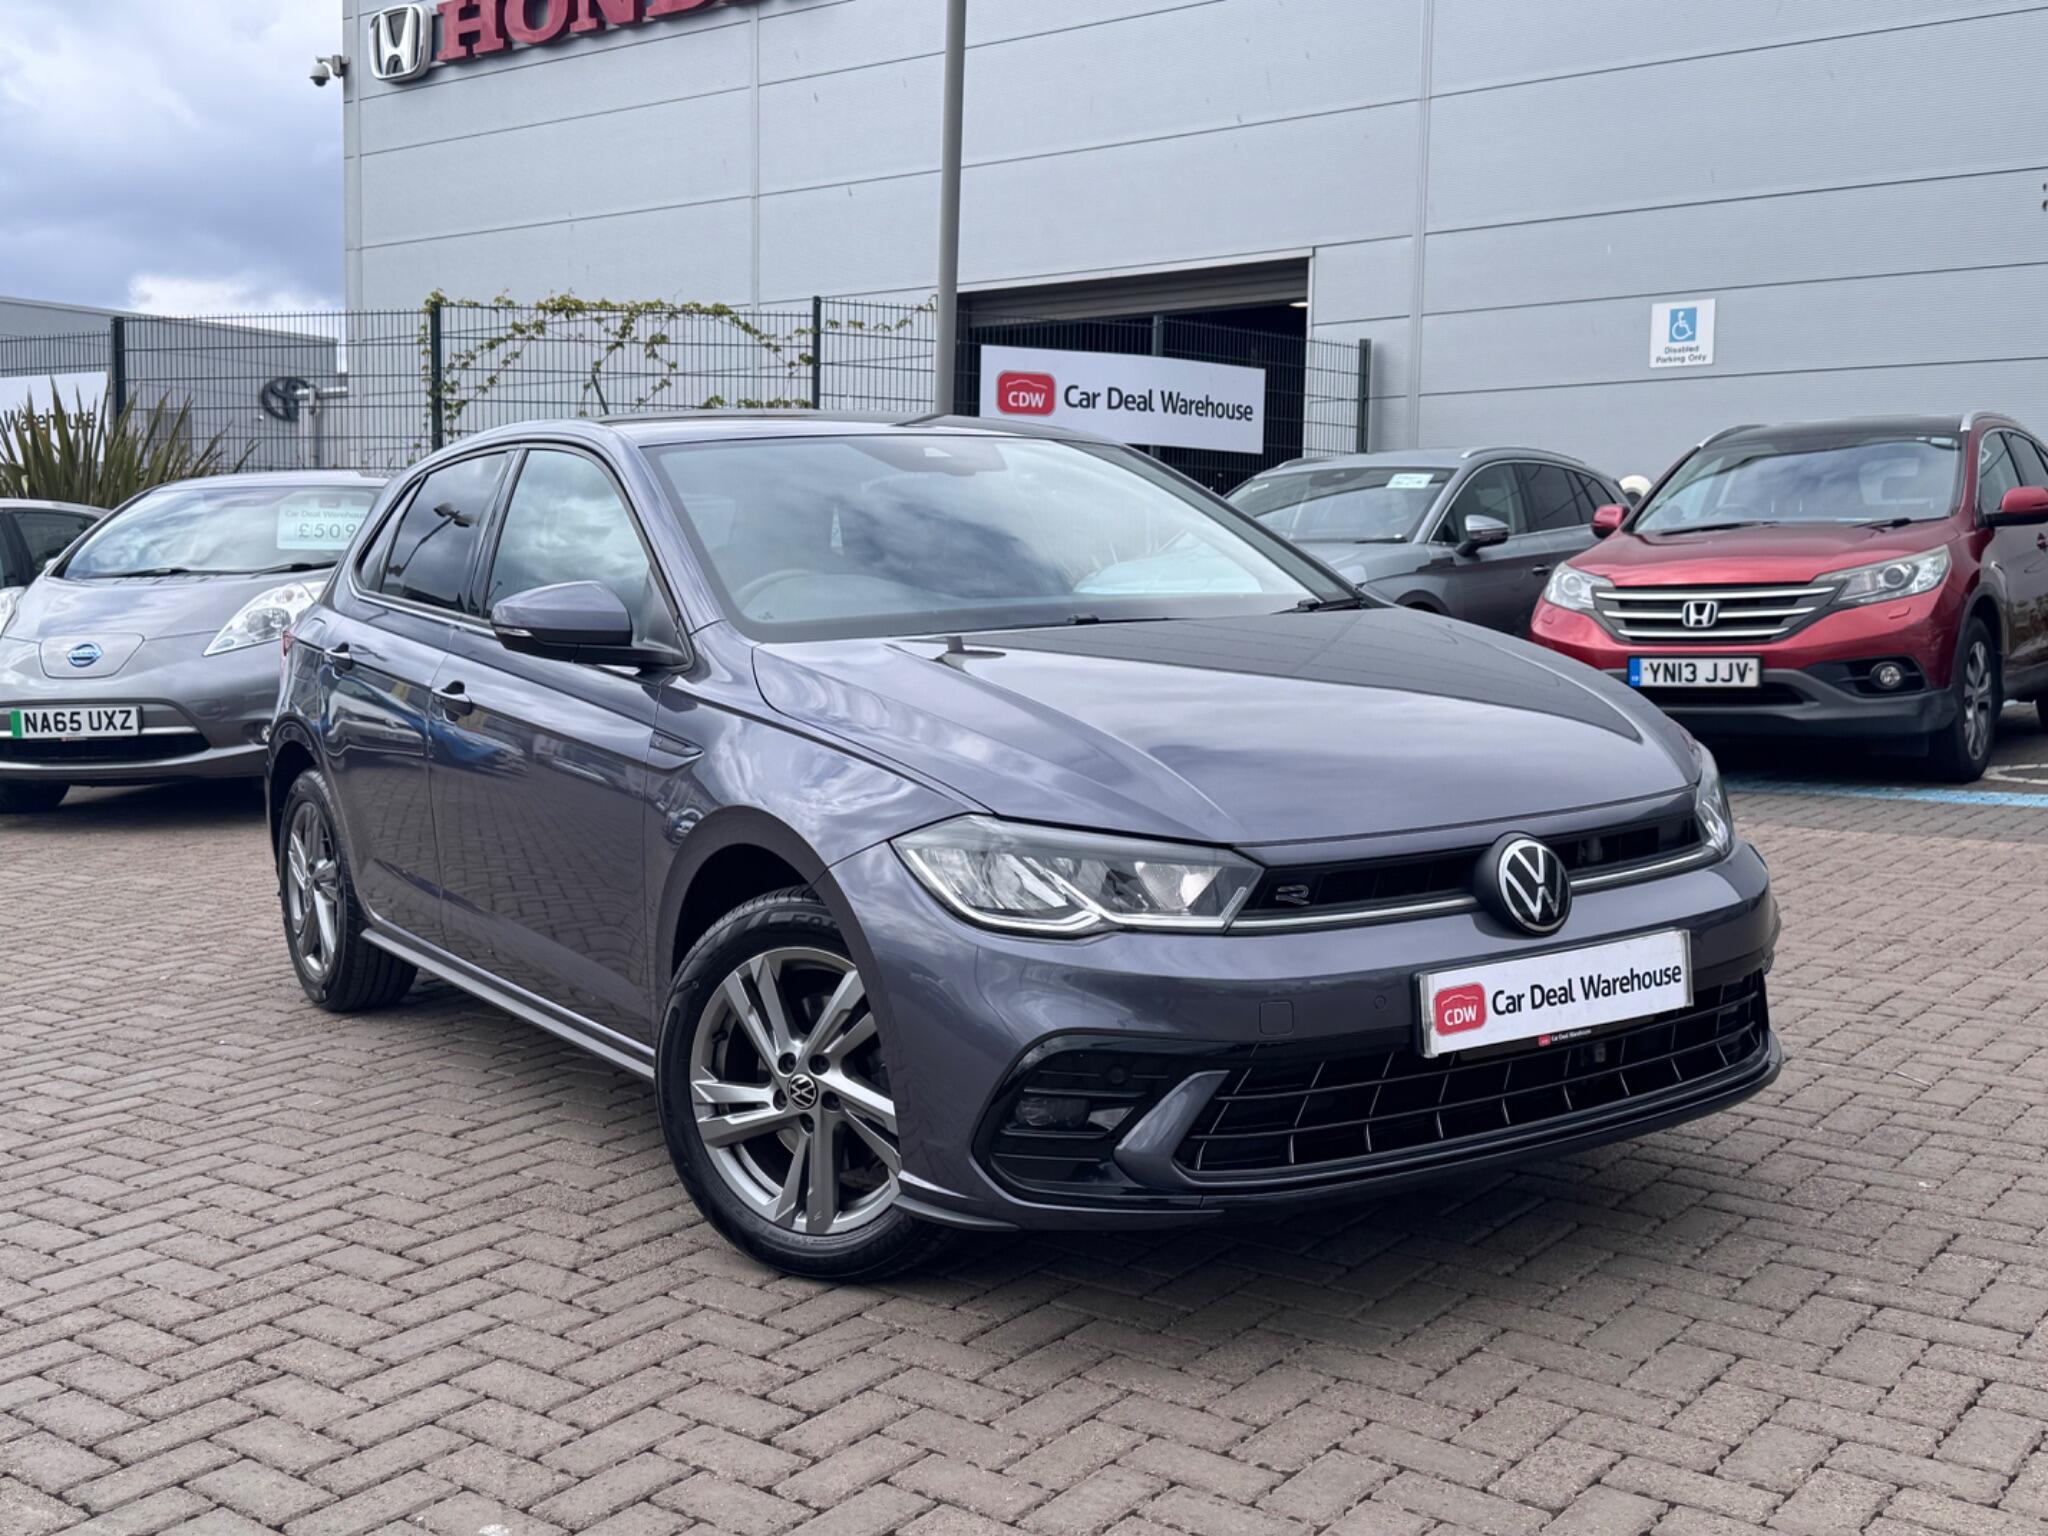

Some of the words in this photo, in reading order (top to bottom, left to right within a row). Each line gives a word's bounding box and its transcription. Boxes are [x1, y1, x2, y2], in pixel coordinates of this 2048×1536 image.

[1007, 391, 1046, 408] CDW
[1063, 384, 1101, 410] Car
[1107, 386, 1155, 413] Deal
[1160, 390, 1254, 422] Warehouse
[1648, 662, 1698, 683] YN13
[1705, 662, 1749, 683] JJV
[23, 711, 83, 733] NA65
[88, 709, 134, 731] UXZ
[1492, 990, 1525, 1016] Car
[1530, 979, 1576, 1010] Deal
[1580, 965, 1683, 1001] Warehouse
[1443, 1004, 1477, 1026] CDW
